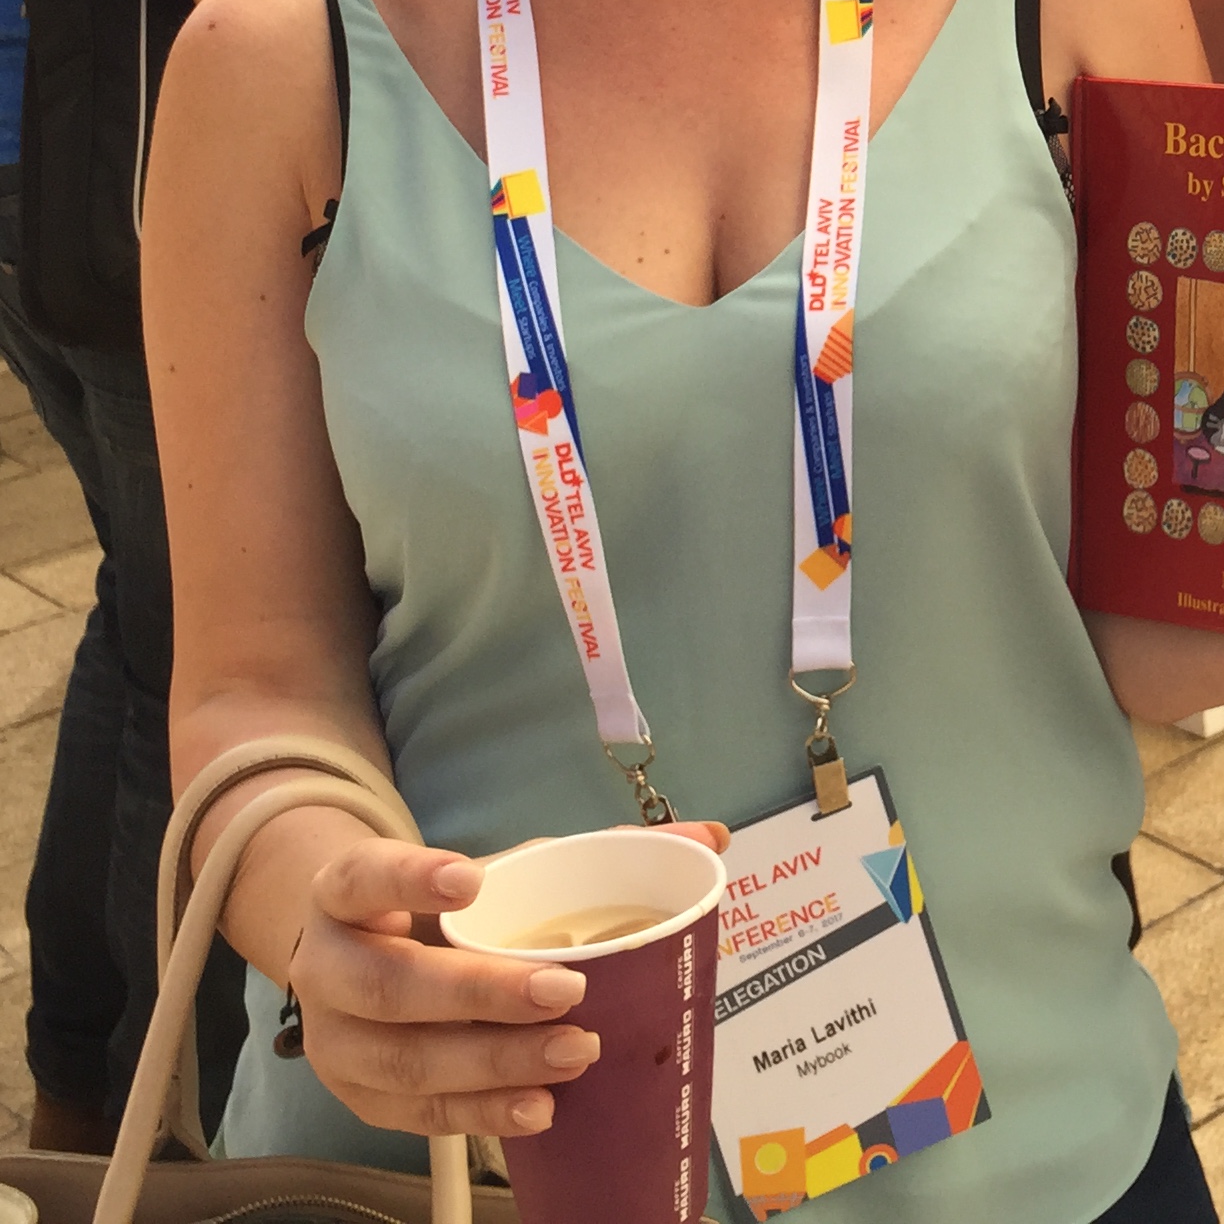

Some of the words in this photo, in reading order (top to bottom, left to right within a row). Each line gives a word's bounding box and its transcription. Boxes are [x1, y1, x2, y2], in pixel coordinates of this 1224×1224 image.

[488, 22, 510, 101] FESTIVAL
[840, 115, 861, 195] FESTIVAL
[817, 198, 834, 235] AVIV
[1187, 171, 1214, 202] by
[813, 238, 831, 269] TEL
[831, 198, 856, 311] INNOVATION
[508, 278, 528, 315] Meet
[809, 273, 828, 312] DLD
[554, 442, 578, 485] DLD
[565, 488, 584, 525] TEL
[532, 446, 577, 574] INNOVATION
[564, 576, 601, 663] FESTIVAL
[573, 528, 596, 571] AVIV
[726, 874, 767, 901] TEL
[771, 846, 822, 885] AVIV
[717, 892, 841, 960] NFERENCE
[738, 935, 794, 964] September
[821, 912, 844, 928] 2017
[683, 933, 693, 1002] MAURO
[715, 943, 827, 1021] ELEGATION
[682, 1008, 692, 1076] MAURO
[752, 1037, 807, 1074] Maria
[811, 997, 877, 1044] Lavithi
[796, 1042, 852, 1078] Mybook
[680, 1083, 690, 1151] MAURO
[679, 1157, 689, 1223] MAURO
